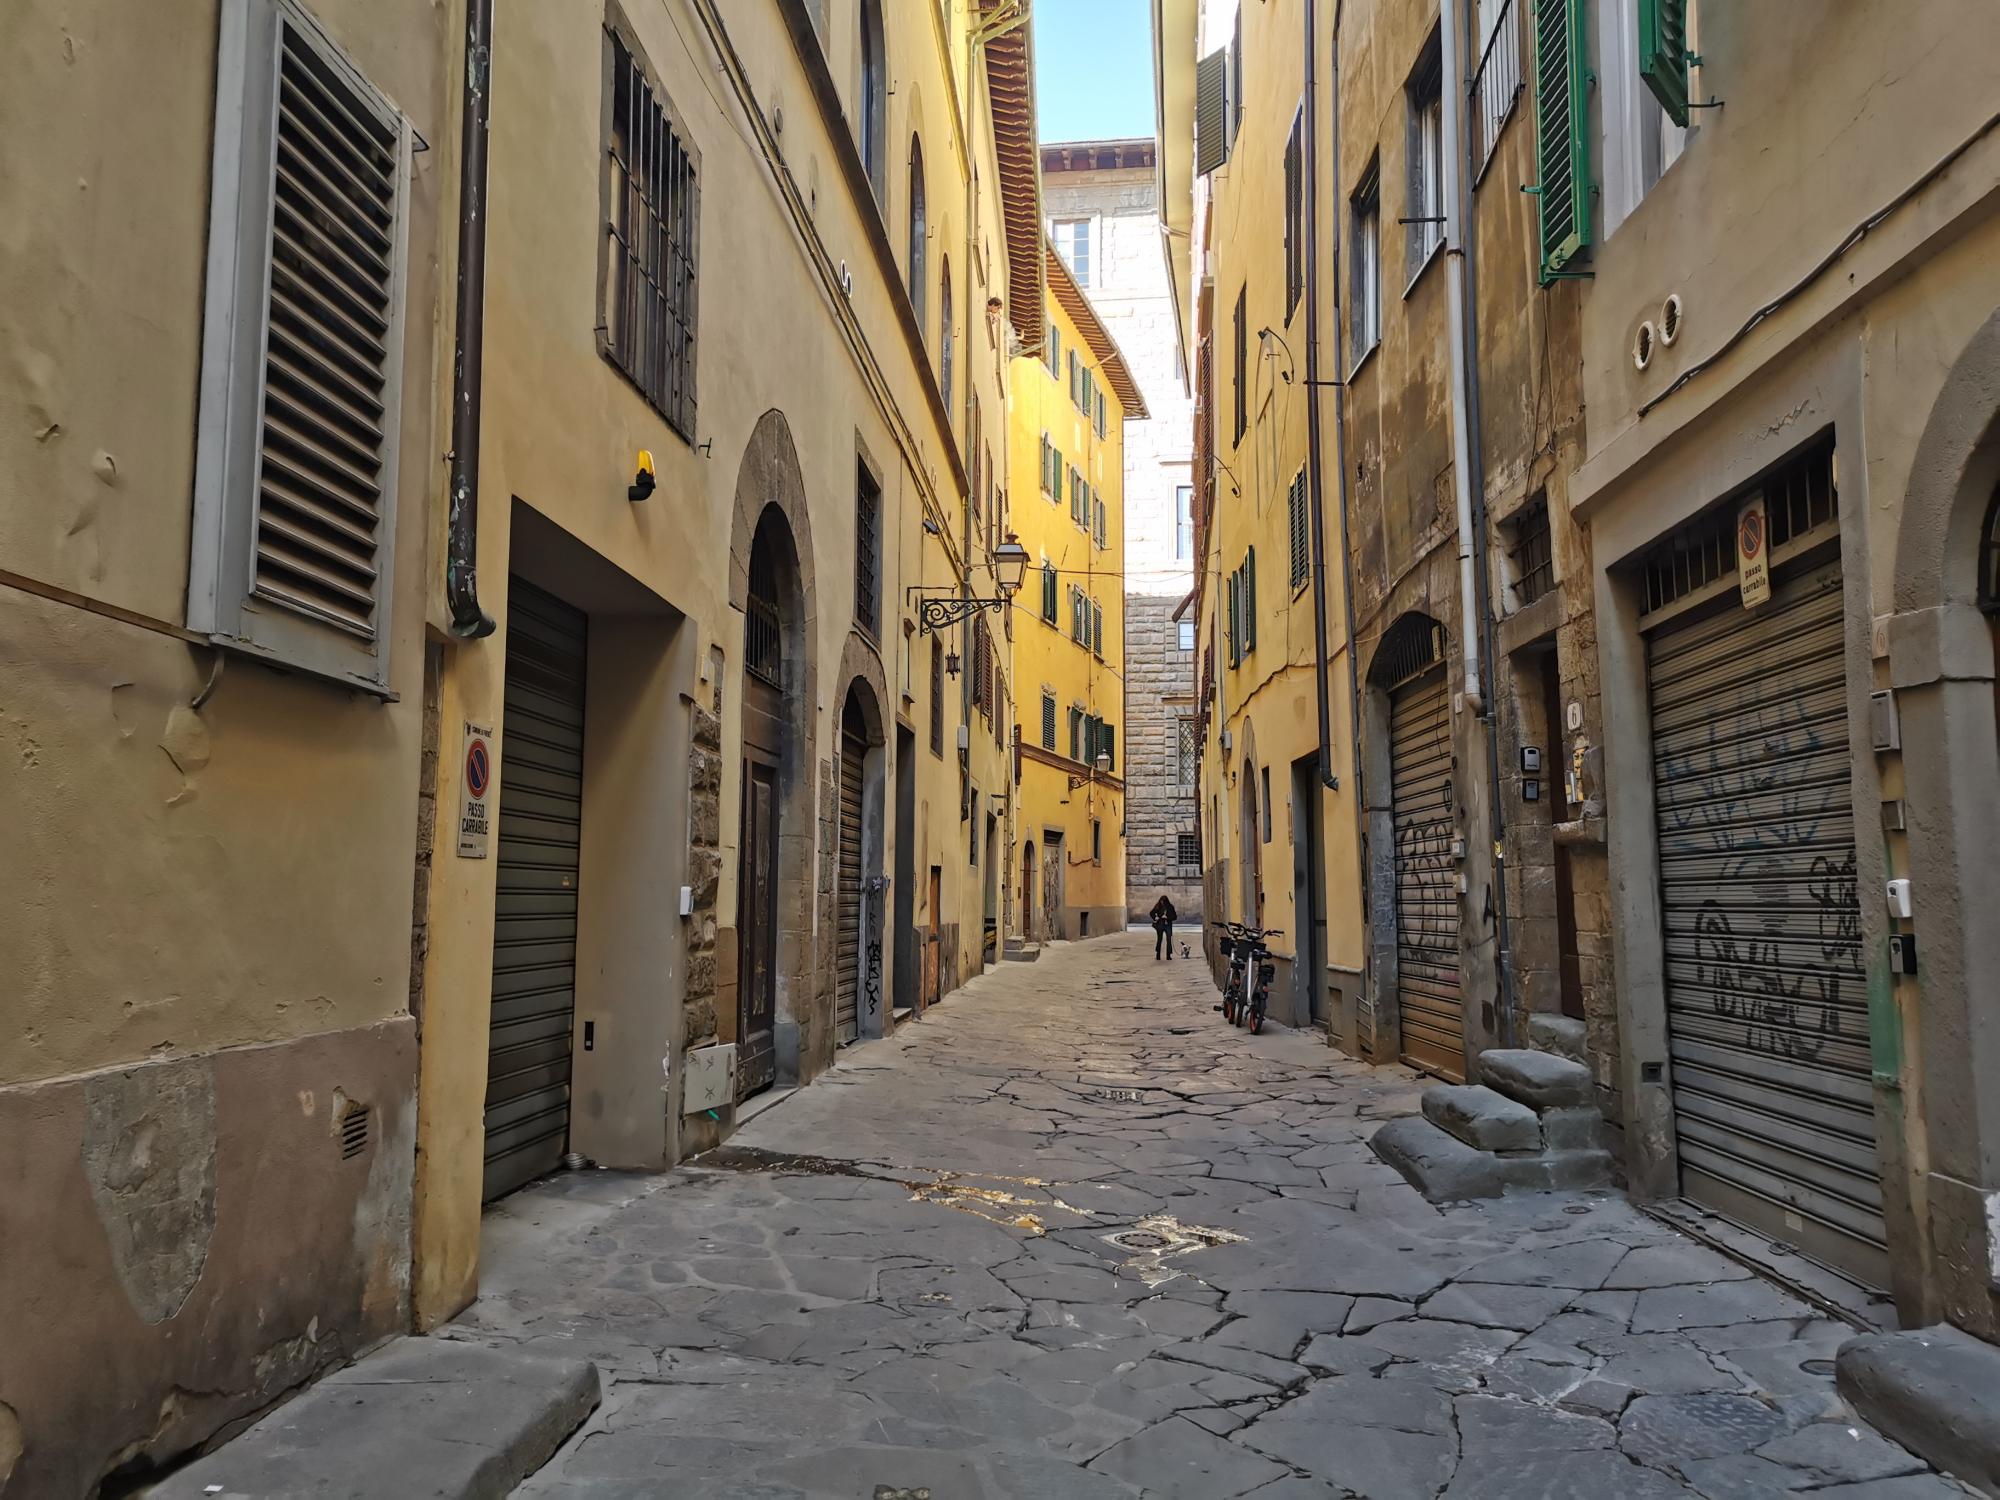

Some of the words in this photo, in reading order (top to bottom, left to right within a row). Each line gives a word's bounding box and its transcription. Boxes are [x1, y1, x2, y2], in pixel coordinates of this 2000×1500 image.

[1745, 564, 1762, 580] passo
[1743, 576, 1766, 595] carrabile
[467, 801, 485, 818] PASSO
[461, 817, 489, 835] CARRABILE
